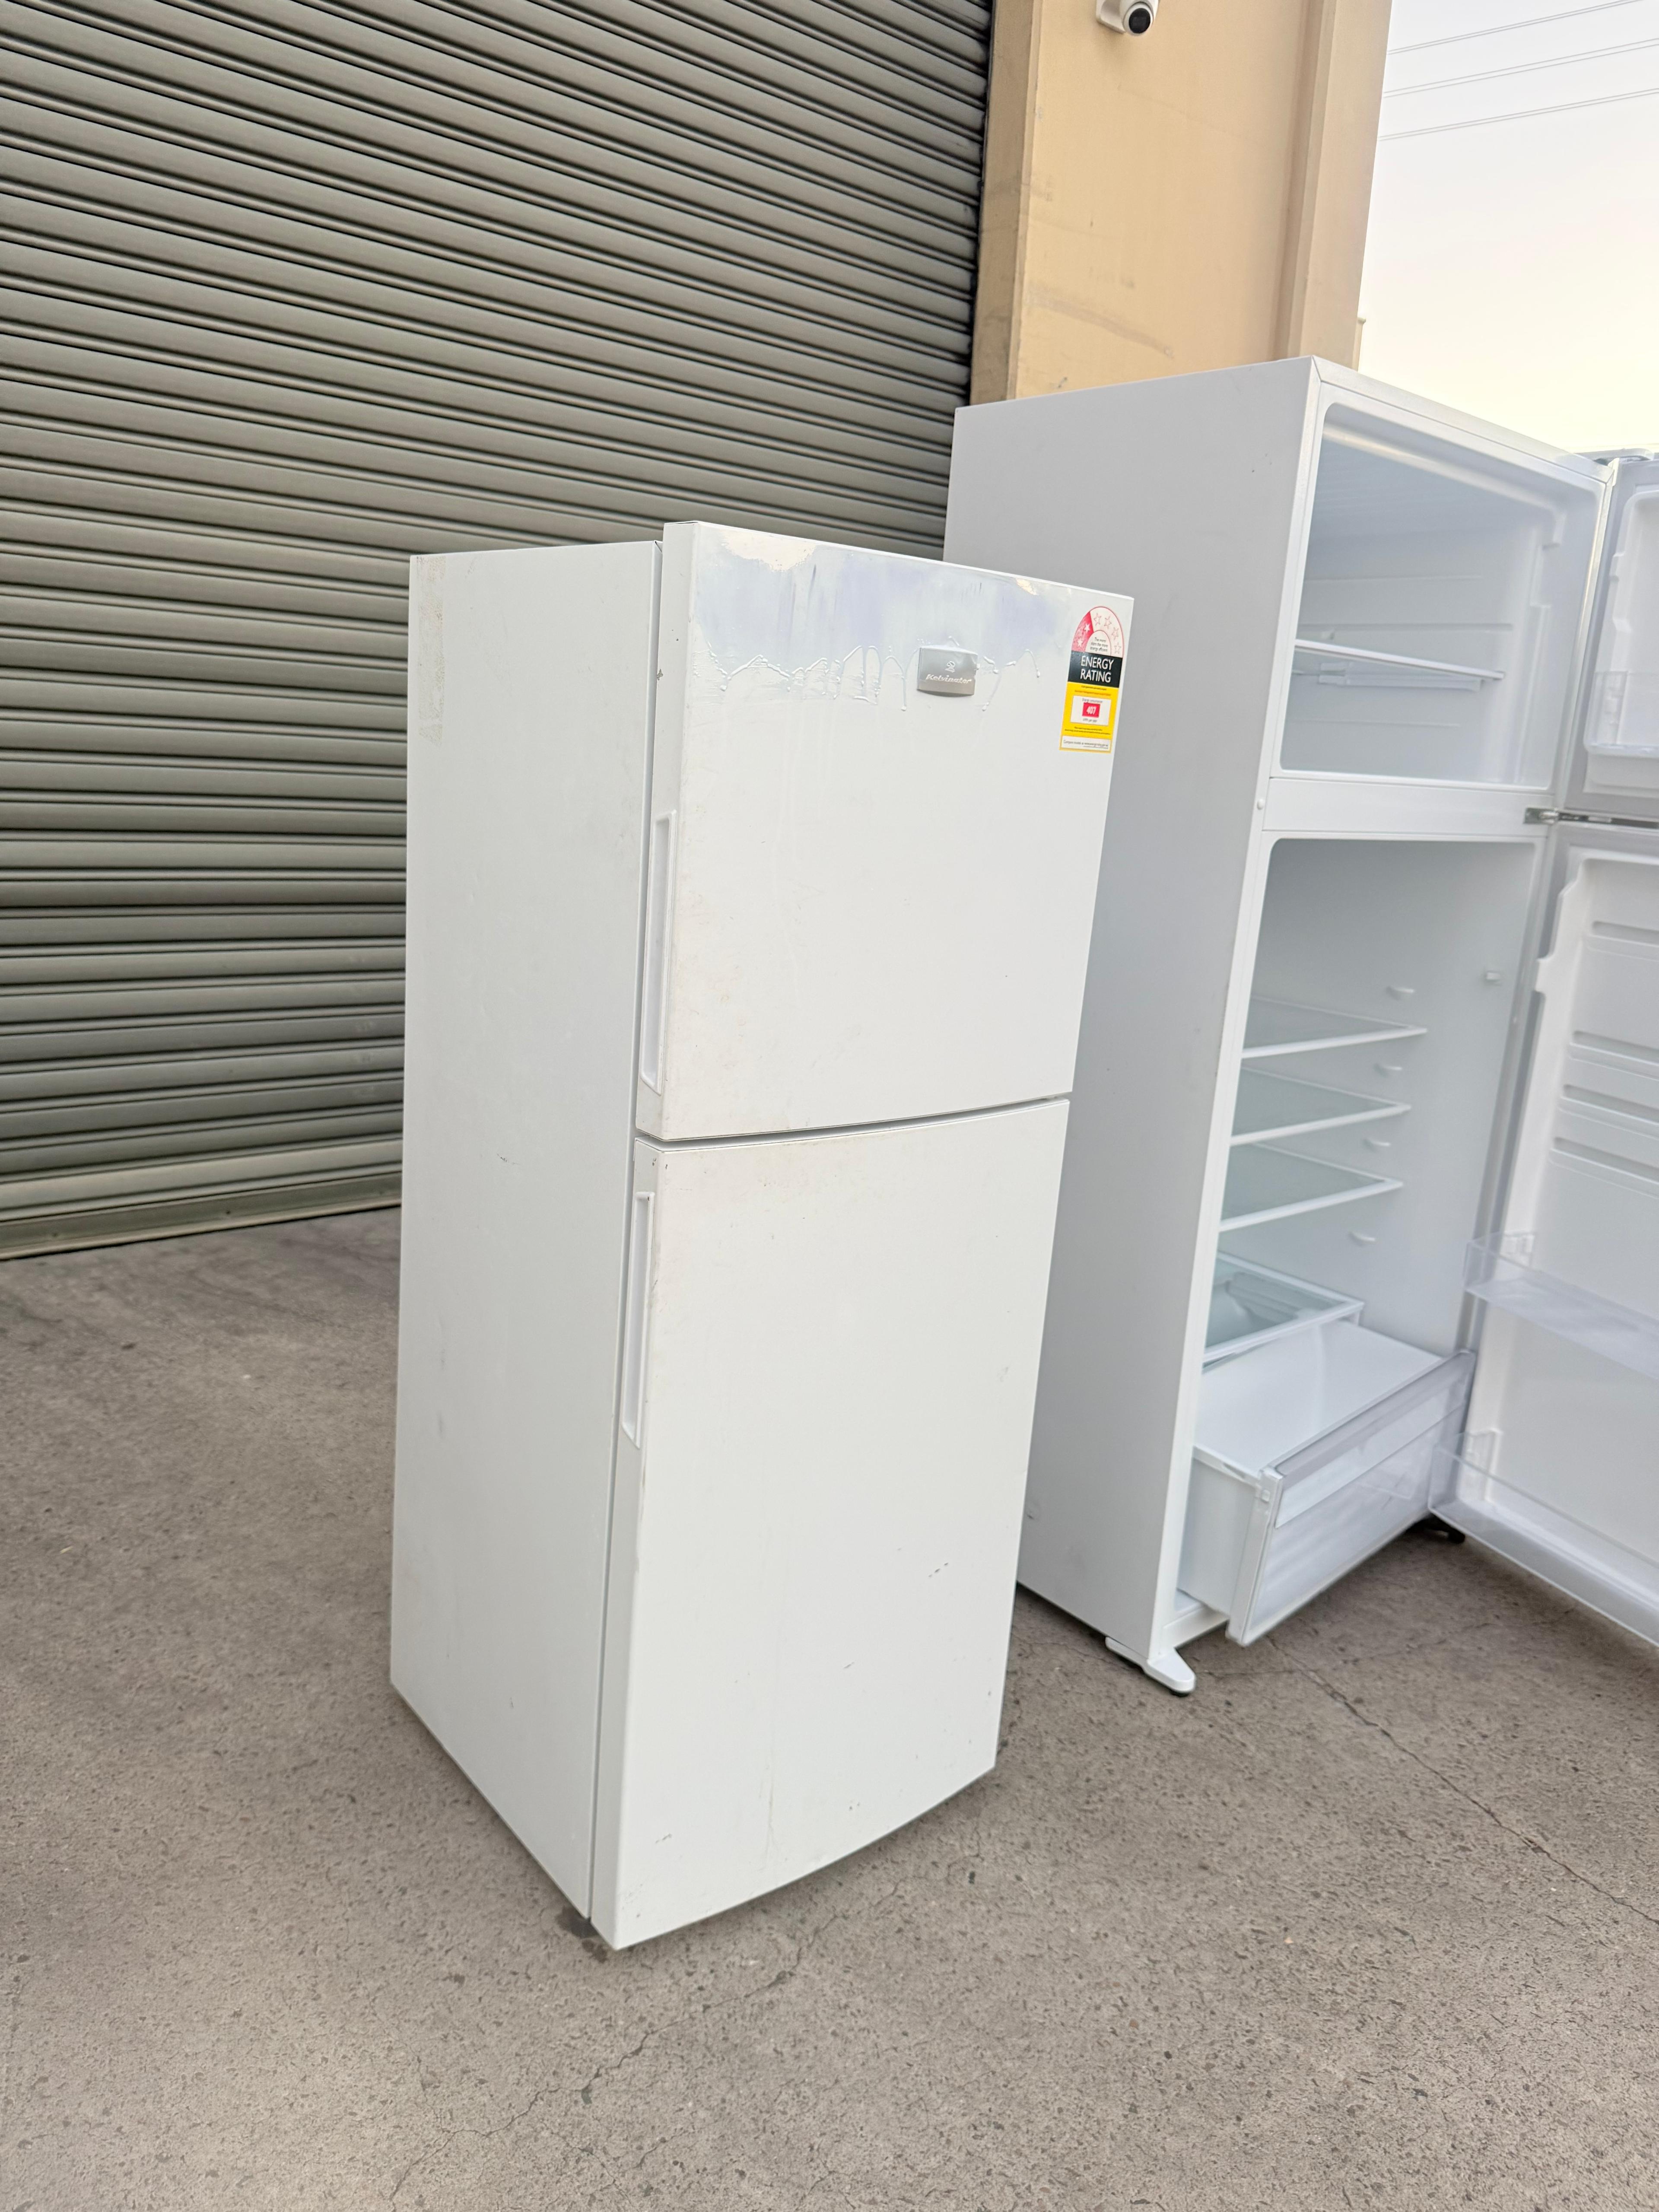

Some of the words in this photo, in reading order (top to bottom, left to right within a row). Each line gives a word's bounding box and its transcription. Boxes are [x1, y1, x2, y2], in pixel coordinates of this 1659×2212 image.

[1081, 655, 1114, 670] ENERGY
[926, 674, 972, 684] Kelvinator
[1080, 668, 1111, 683] RATING
[1086, 706, 1096, 715] 407
